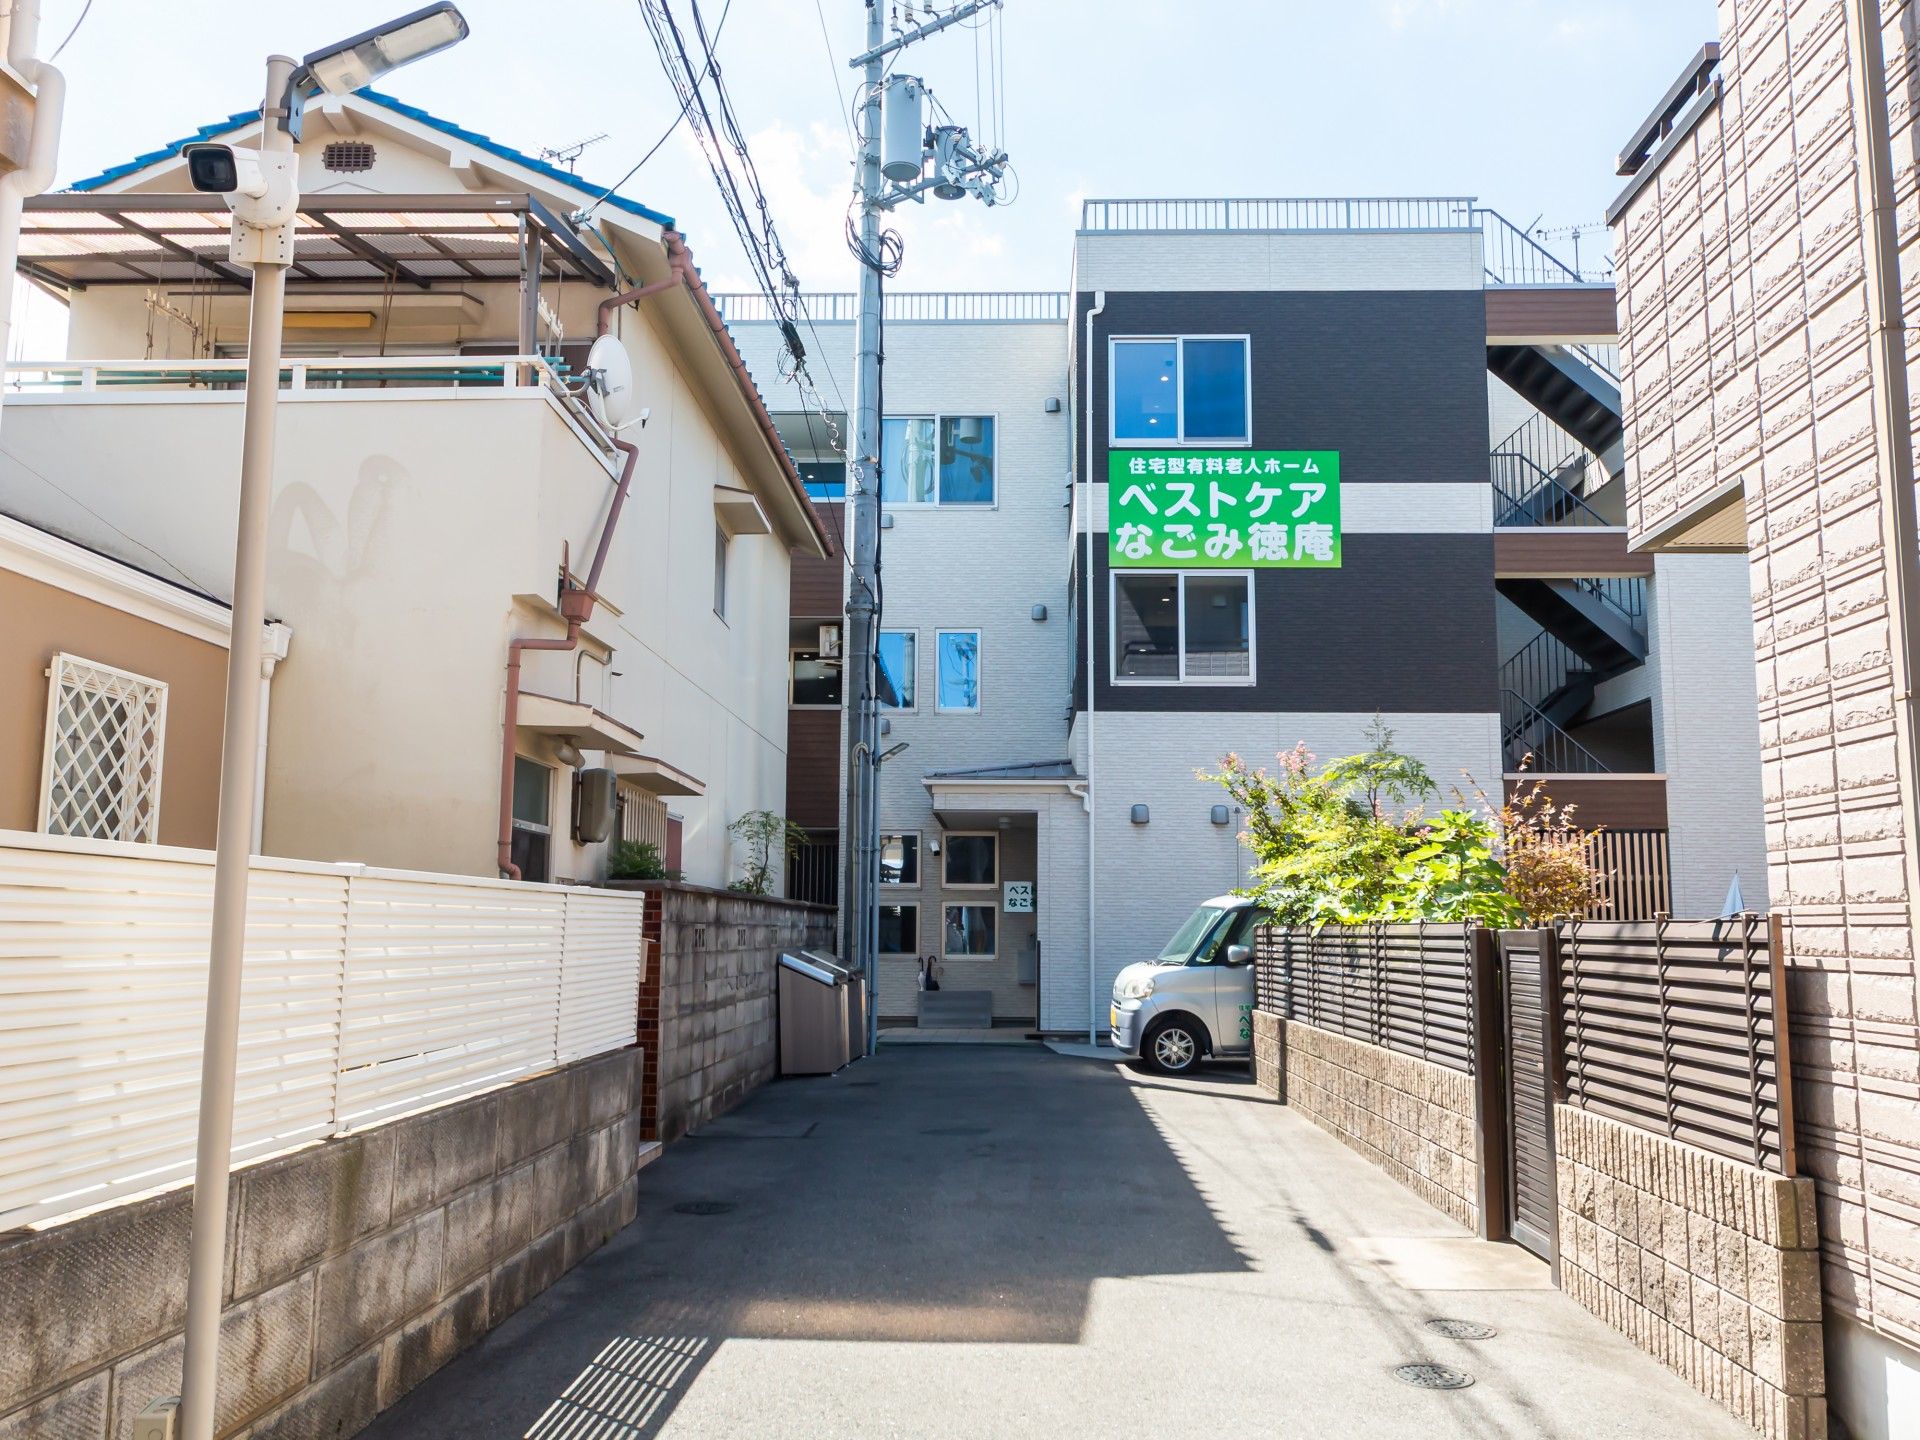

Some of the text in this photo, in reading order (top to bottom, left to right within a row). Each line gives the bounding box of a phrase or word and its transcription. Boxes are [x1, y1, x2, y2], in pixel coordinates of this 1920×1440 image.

[1128, 457, 1320, 475] 住宅型有料老人ホーム
[1118, 481, 1327, 519] ベストケア
[1115, 521, 1334, 562] なごみ徳庵
